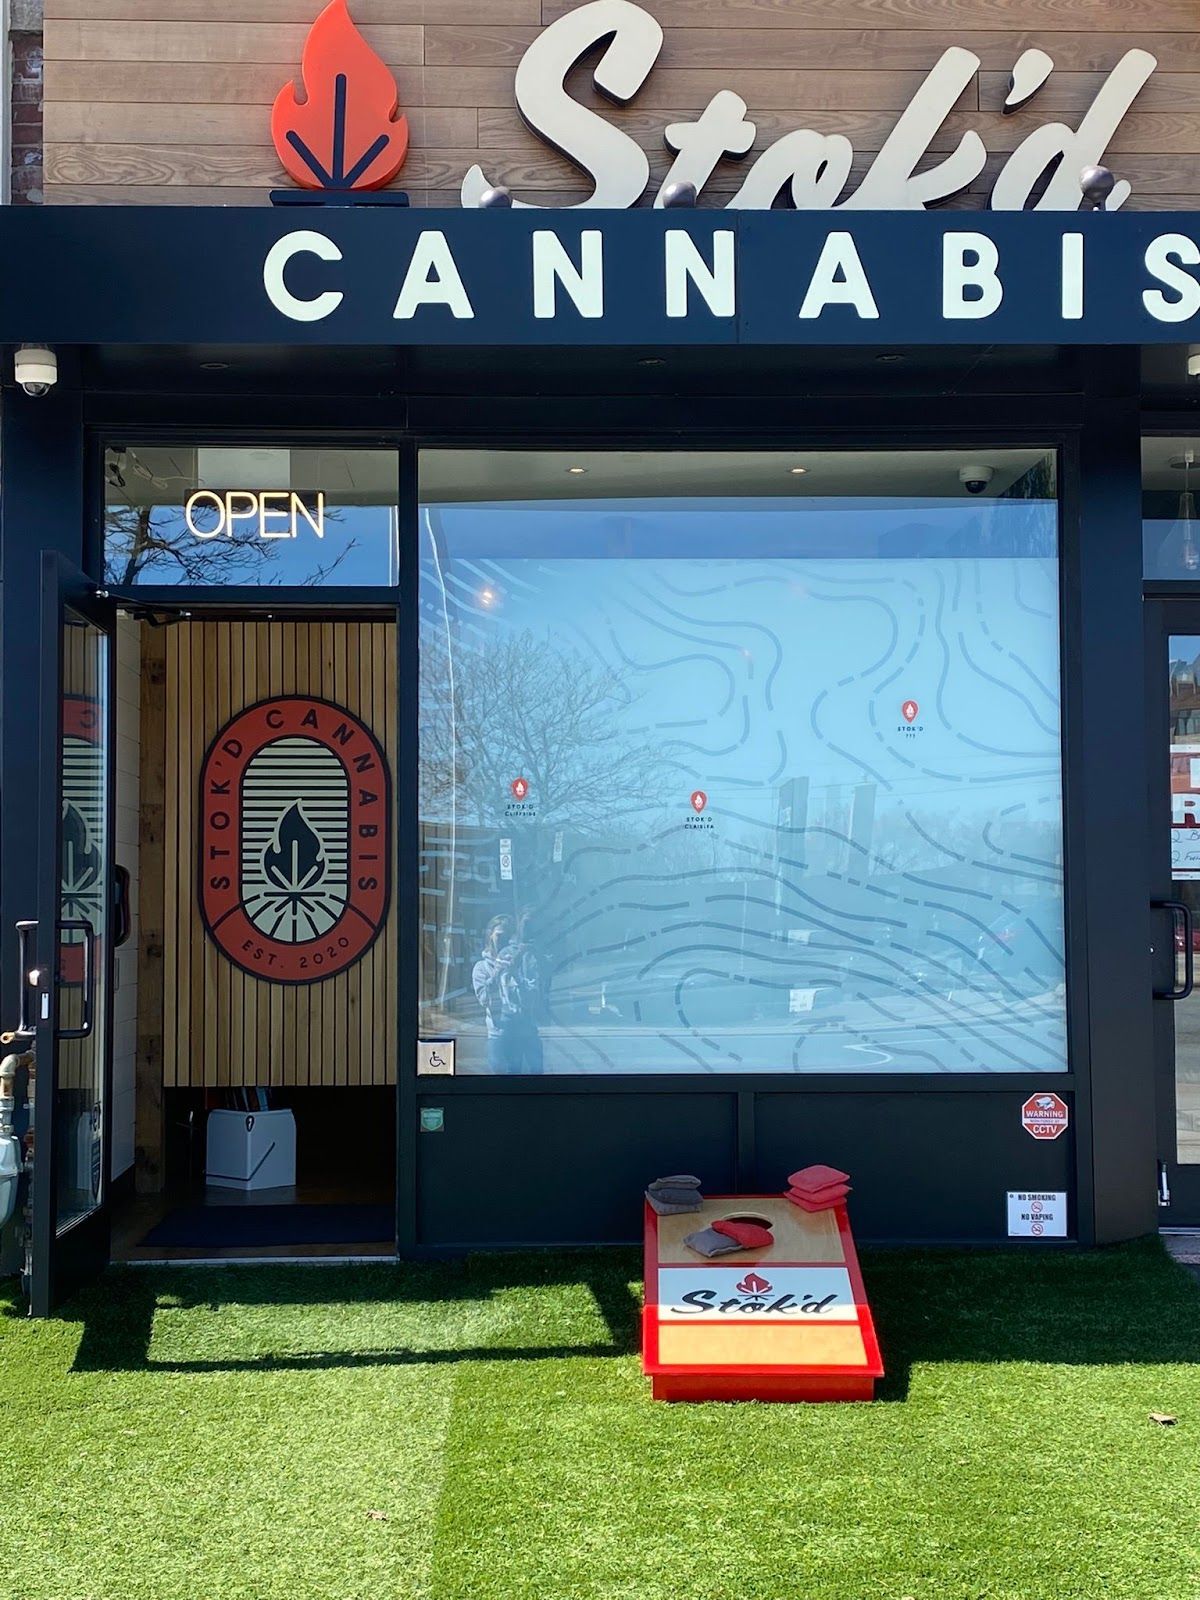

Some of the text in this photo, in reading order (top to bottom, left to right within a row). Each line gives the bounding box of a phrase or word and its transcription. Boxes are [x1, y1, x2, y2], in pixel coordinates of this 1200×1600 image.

[461, 0, 1158, 210] Stok'd
[263, 230, 1200, 322] CANNABIS
[185, 490, 325, 538] OPEN
[210, 708, 379, 891] STOK'D CANNABIS
[242, 936, 350, 969] EST. 2020
[1025, 1110, 1064, 1118] WARNING
[1033, 1125, 1058, 1134] CCTV
[1021, 1213, 1054, 1221] NO VAPING
[670, 1289, 839, 1315] Stok'd
